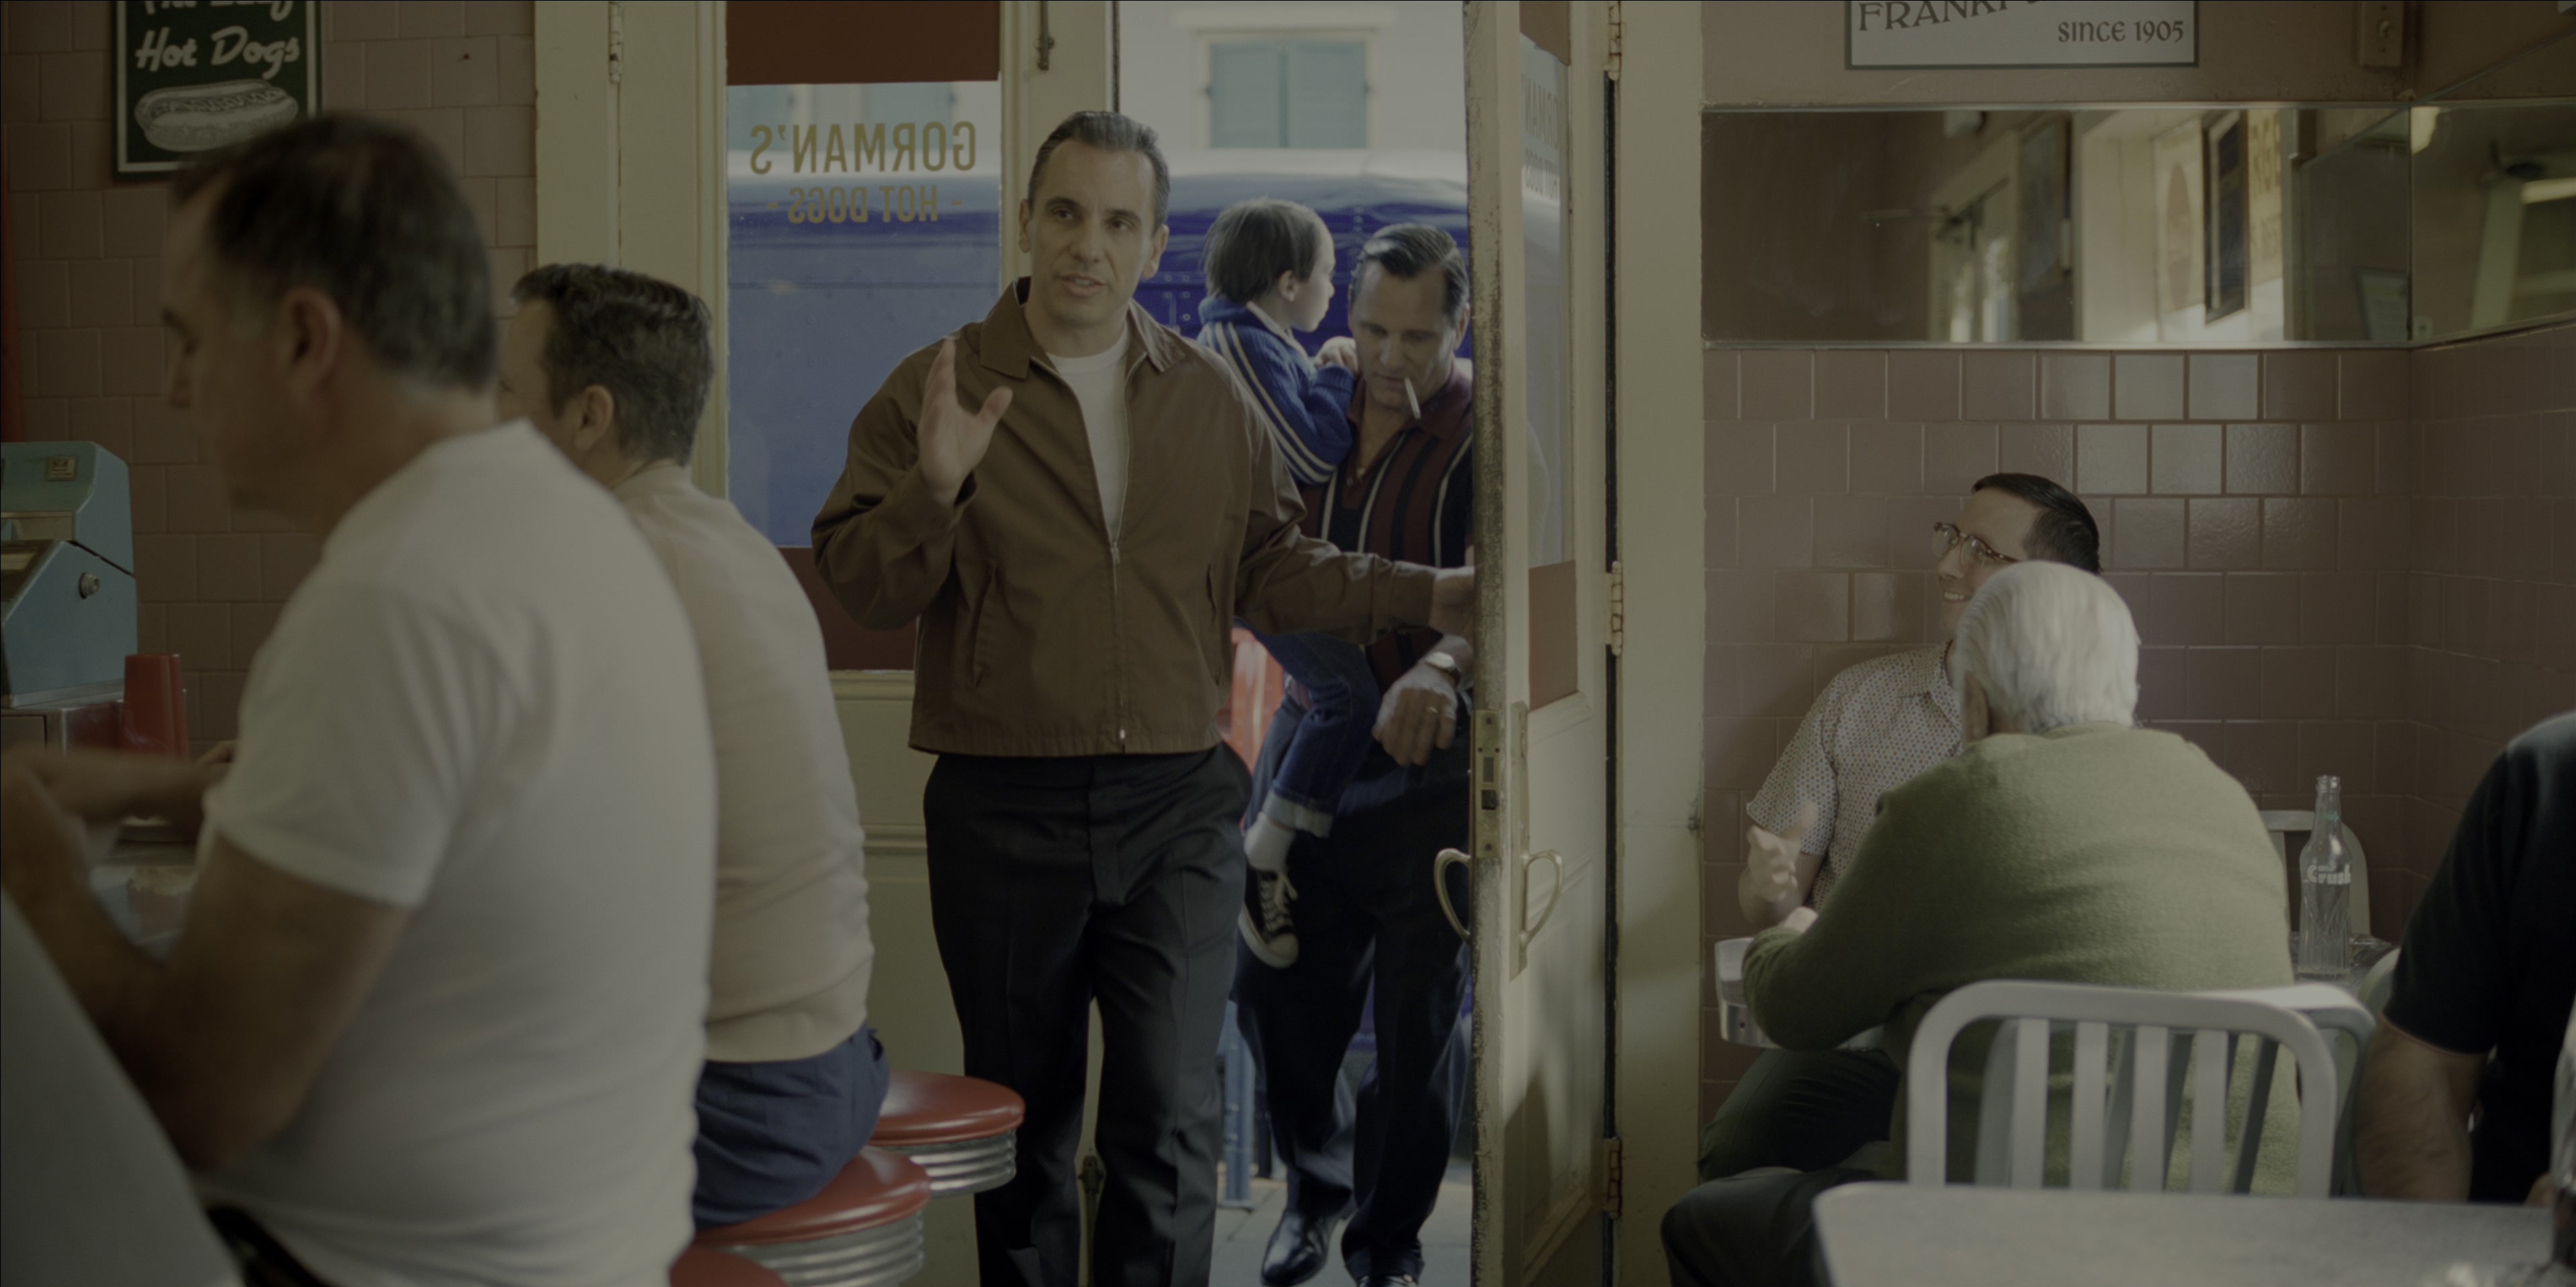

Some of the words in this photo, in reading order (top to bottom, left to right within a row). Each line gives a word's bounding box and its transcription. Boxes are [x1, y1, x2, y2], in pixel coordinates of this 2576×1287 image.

[2057, 20, 2126, 43] SINCE
[2135, 19, 2185, 44] 1905
[135, 26, 198, 72] Hot
[210, 25, 301, 80] Dogs
[2307, 863, 2352, 885] Crush
